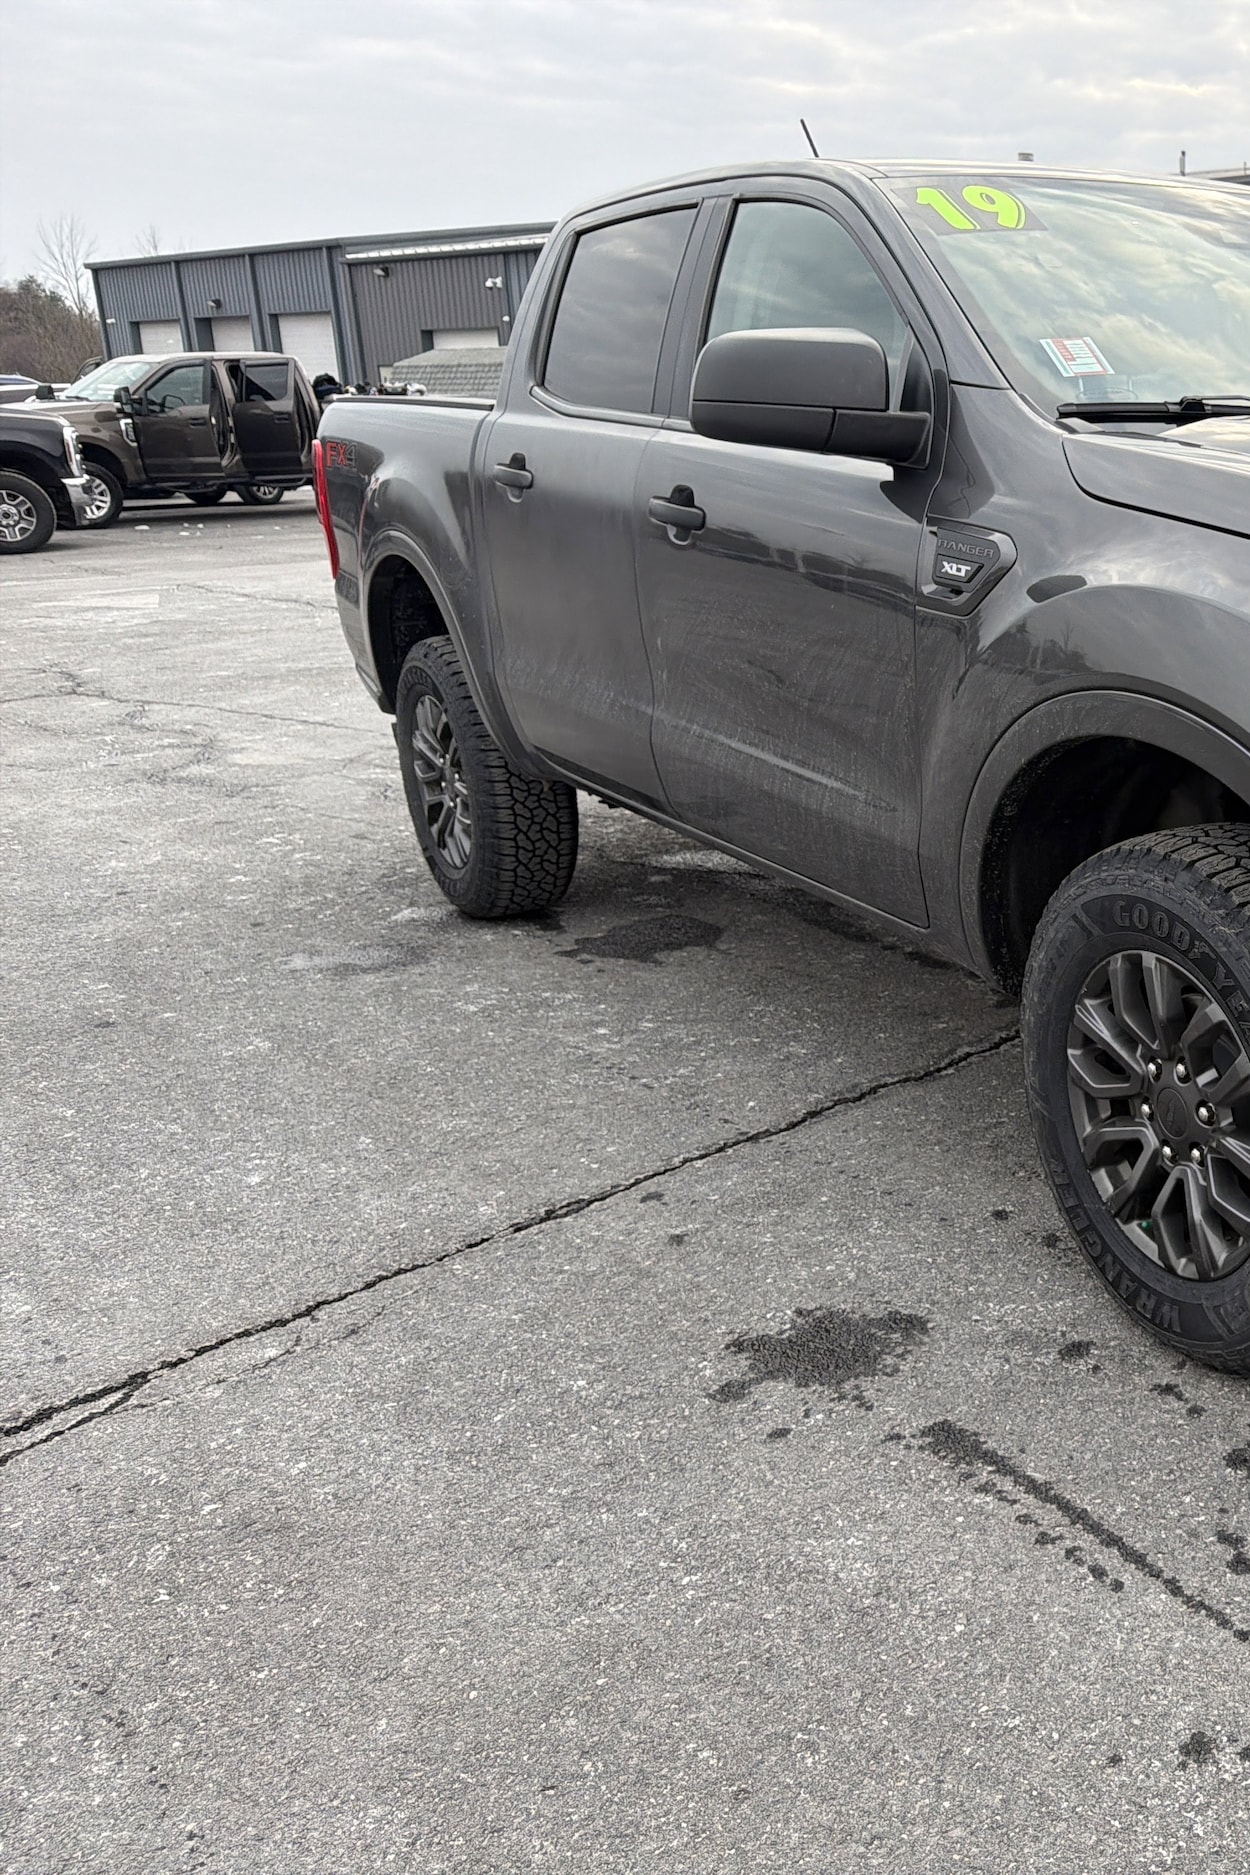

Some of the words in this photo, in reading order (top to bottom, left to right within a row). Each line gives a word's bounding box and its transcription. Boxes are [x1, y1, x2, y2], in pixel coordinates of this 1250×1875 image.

[914, 184, 1027, 231] 19
[325, 439, 358, 470] FX4
[937, 538, 994, 559] RANGER
[940, 560, 972, 577] XLT
